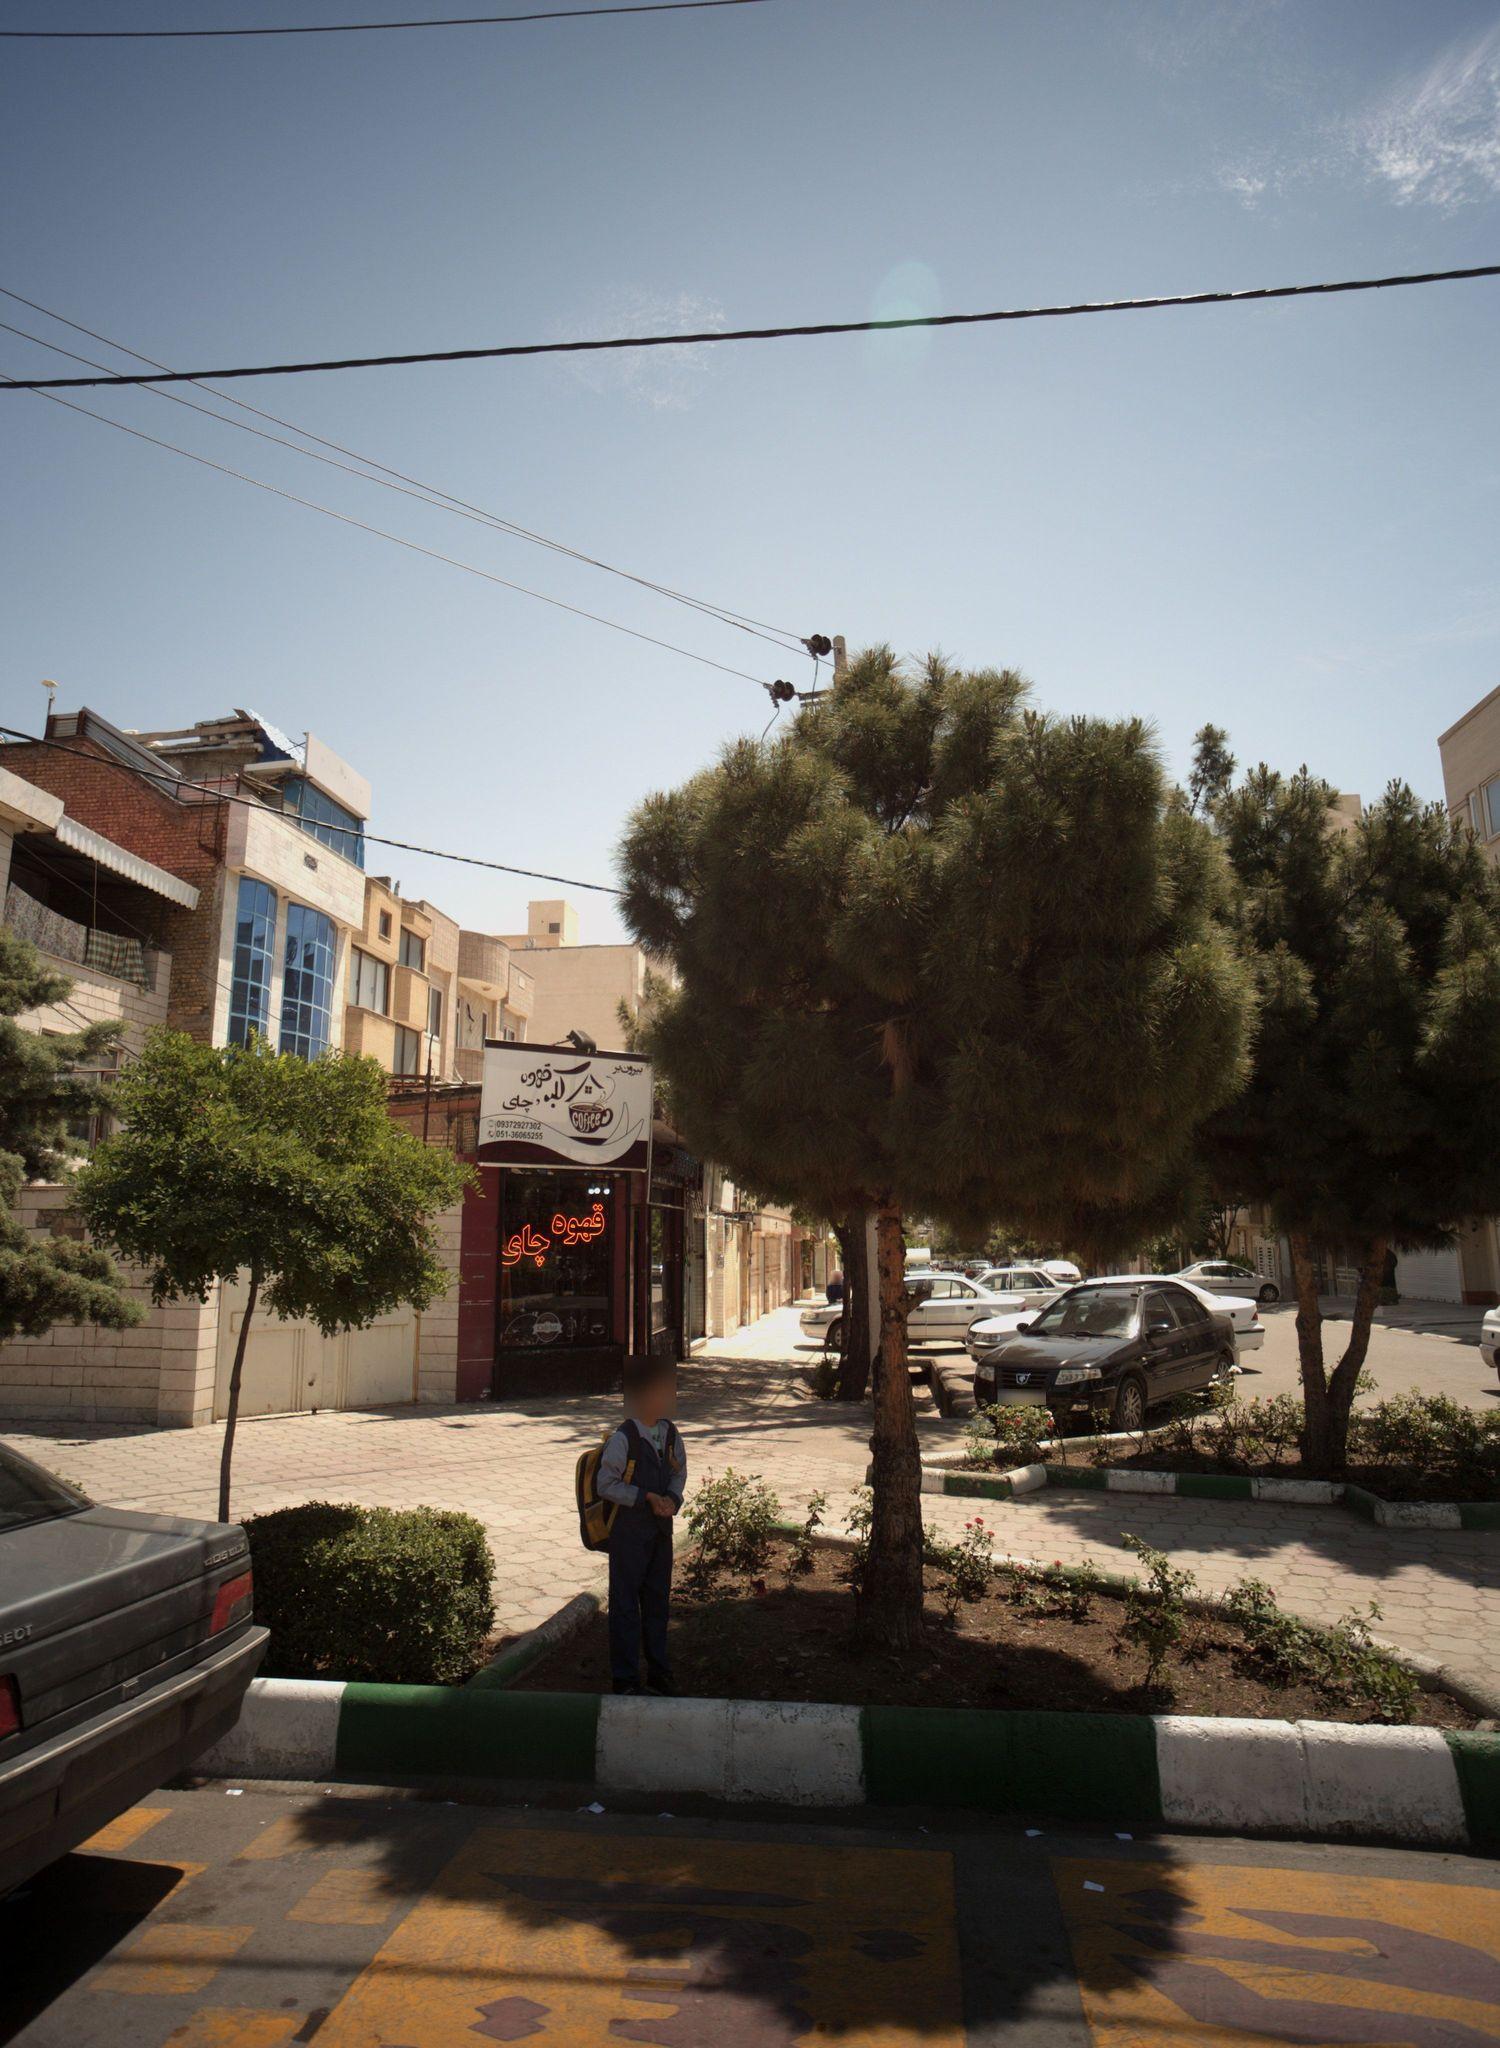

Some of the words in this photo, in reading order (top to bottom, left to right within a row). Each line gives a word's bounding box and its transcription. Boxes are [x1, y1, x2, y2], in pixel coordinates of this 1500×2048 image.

[520, 1063, 552, 1088] قهوه
[502, 1095, 533, 1112] چای
[551, 1203, 605, 1245] قهوه
[501, 1223, 550, 1267] چای
